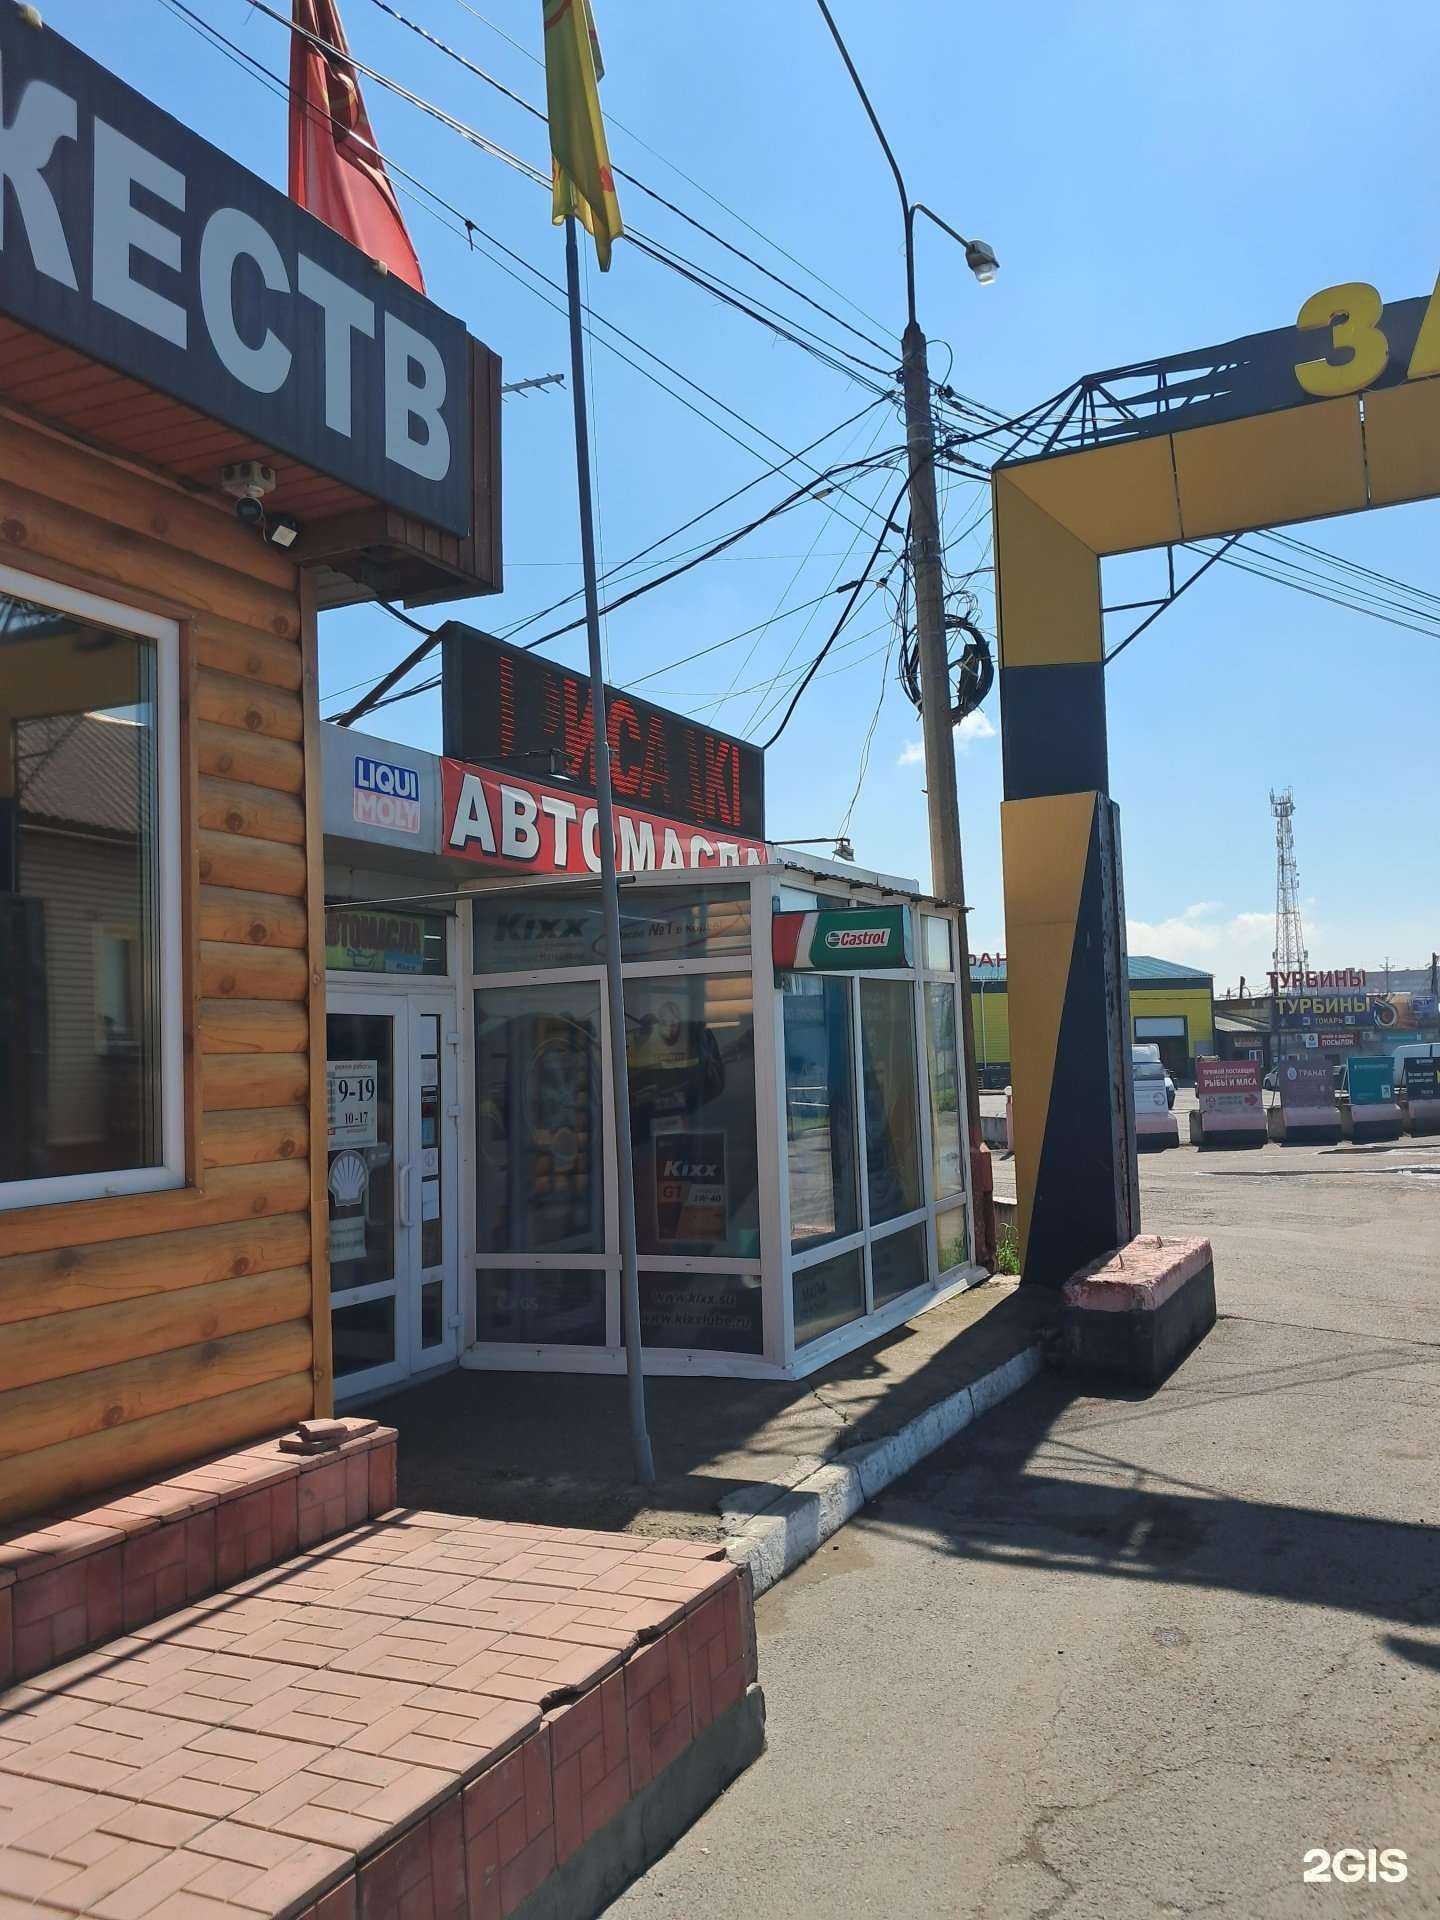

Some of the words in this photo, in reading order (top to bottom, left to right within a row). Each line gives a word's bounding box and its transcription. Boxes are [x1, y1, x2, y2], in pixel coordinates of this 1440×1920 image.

[357, 759, 418, 801] LIQUI
[356, 795, 419, 831] MOLY
[840, 930, 886, 947] Castrol
[1266, 969, 1366, 990] ТУРБИНЫ
[1275, 997, 1370, 1015] ТУРБИНЫ
[338, 1078, 376, 1103] 9-19
[1204, 1079, 1228, 1088] РЫБЫ
[1229, 1079, 1235, 1087] И
[663, 1159, 718, 1177] Kixx
